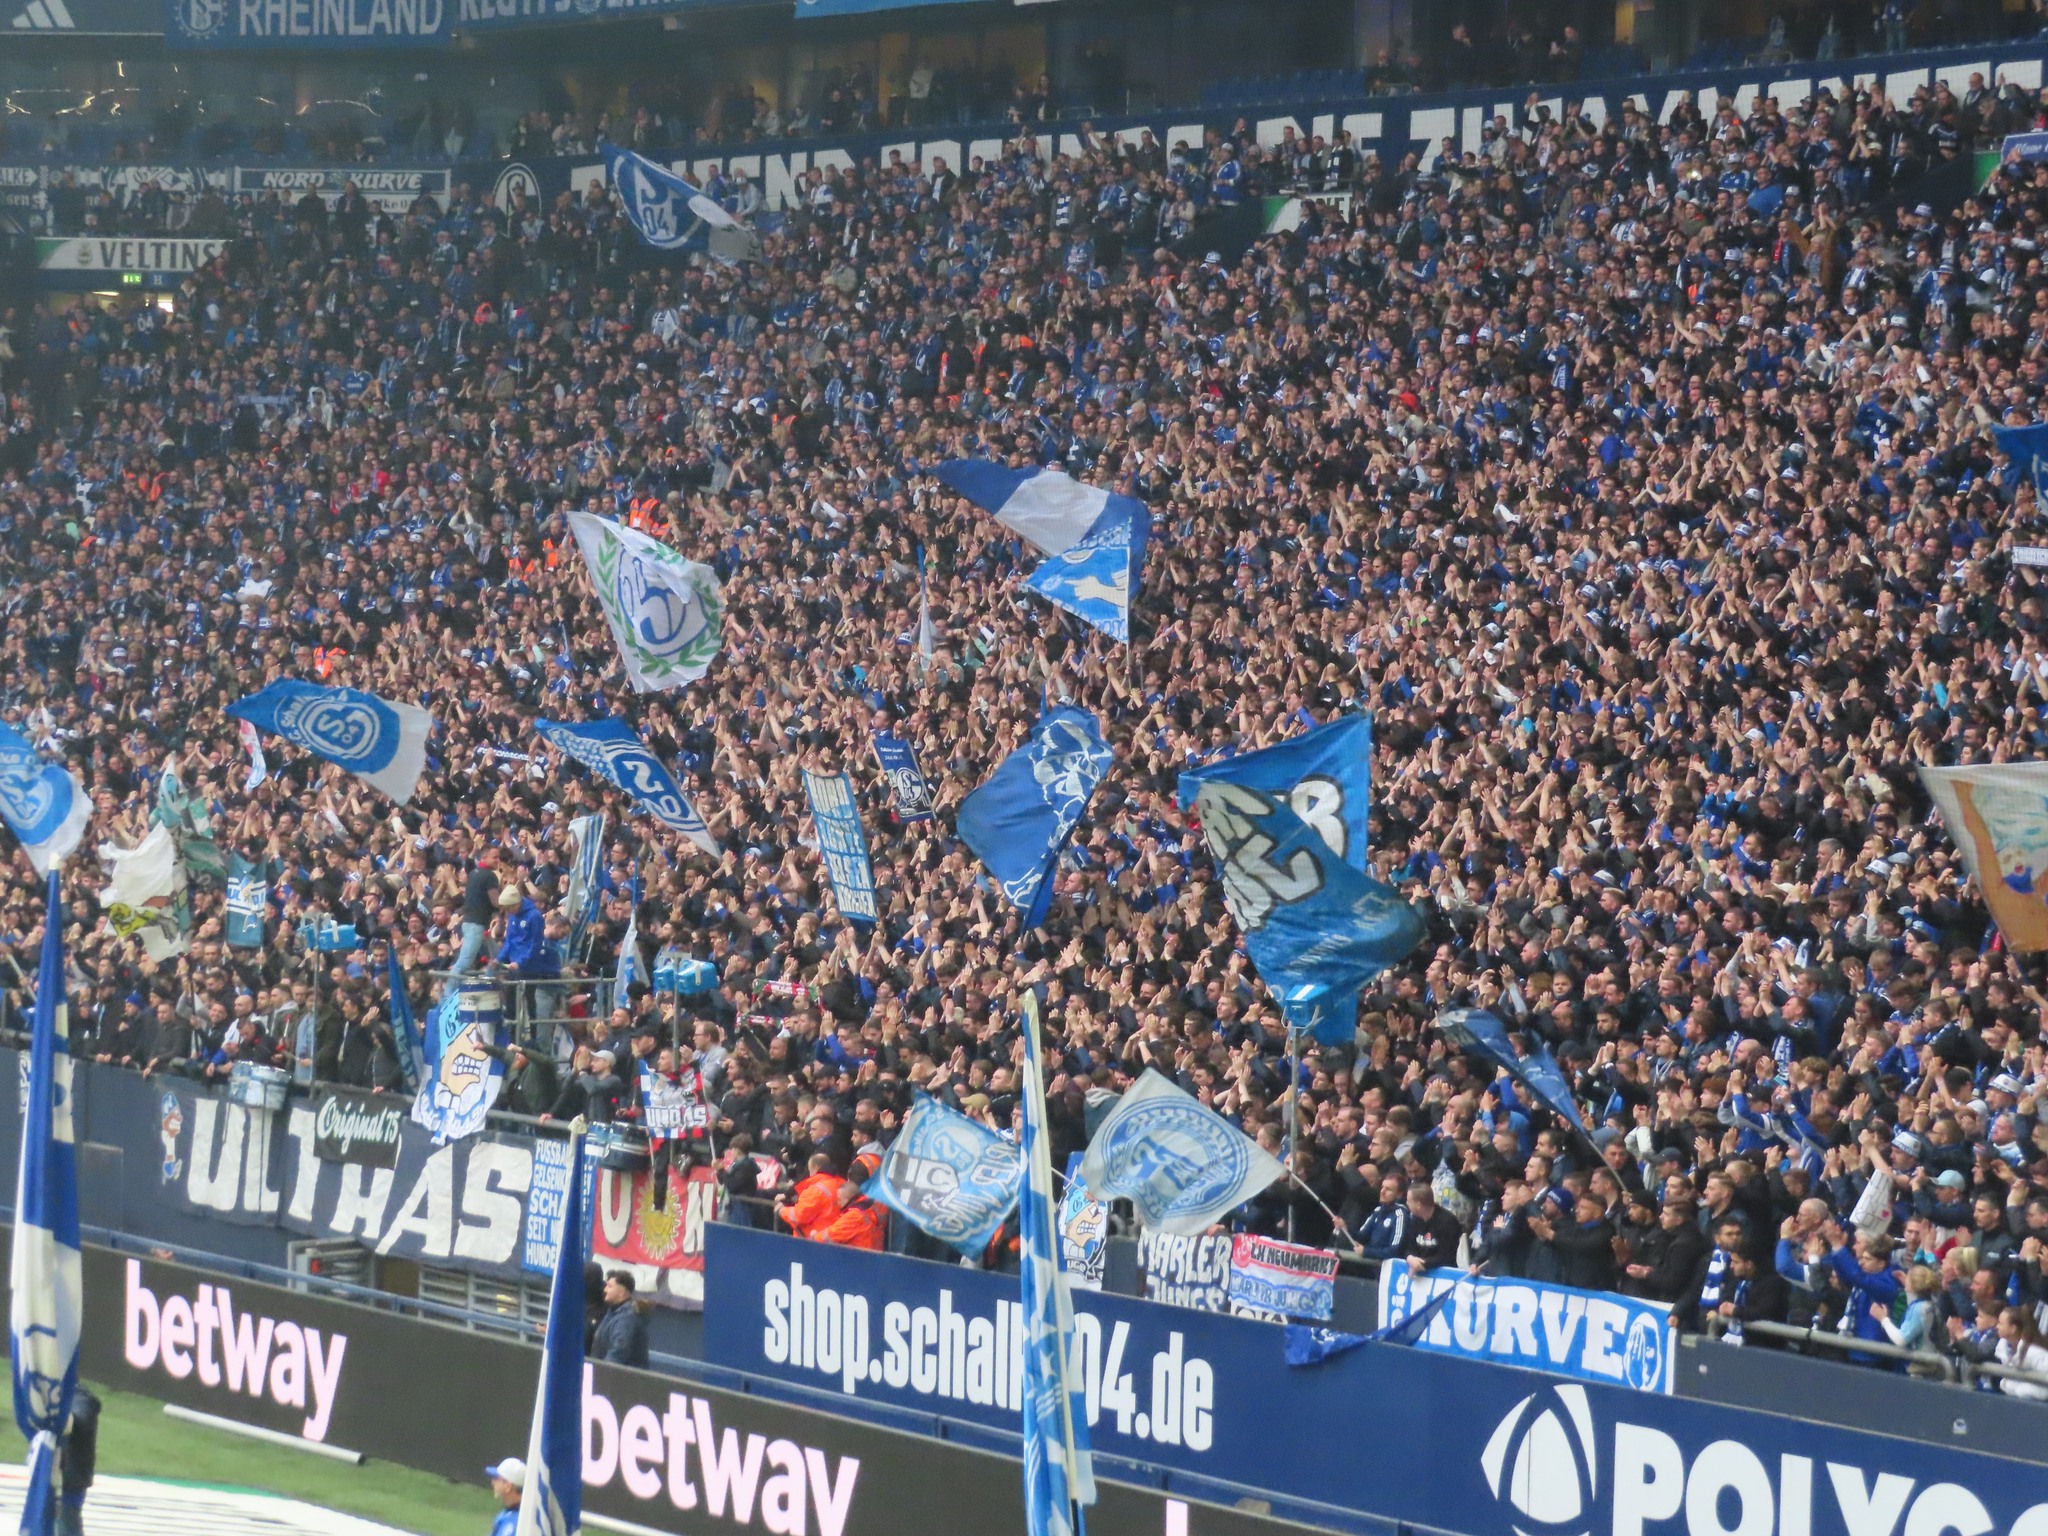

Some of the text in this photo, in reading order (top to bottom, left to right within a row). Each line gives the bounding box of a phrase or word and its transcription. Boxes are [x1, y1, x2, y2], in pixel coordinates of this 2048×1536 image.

[239, 0, 443, 36] RHEINLAND
[263, 171, 424, 190] NORD KURVE
[100, 240, 217, 268] VELTINS
[316, 1094, 387, 1155] Original
[383, 1109, 402, 1143] 75
[525, 1241, 558, 1269] HUNDE
[526, 1215, 548, 1242] SEIT
[1137, 1225, 1233, 1291] MARLER
[124, 1258, 347, 1443] betway
[763, 1261, 1214, 1451] shop.schal04.de
[1409, 1277, 1629, 1380] KURVE
[580, 1361, 861, 1536] betway
